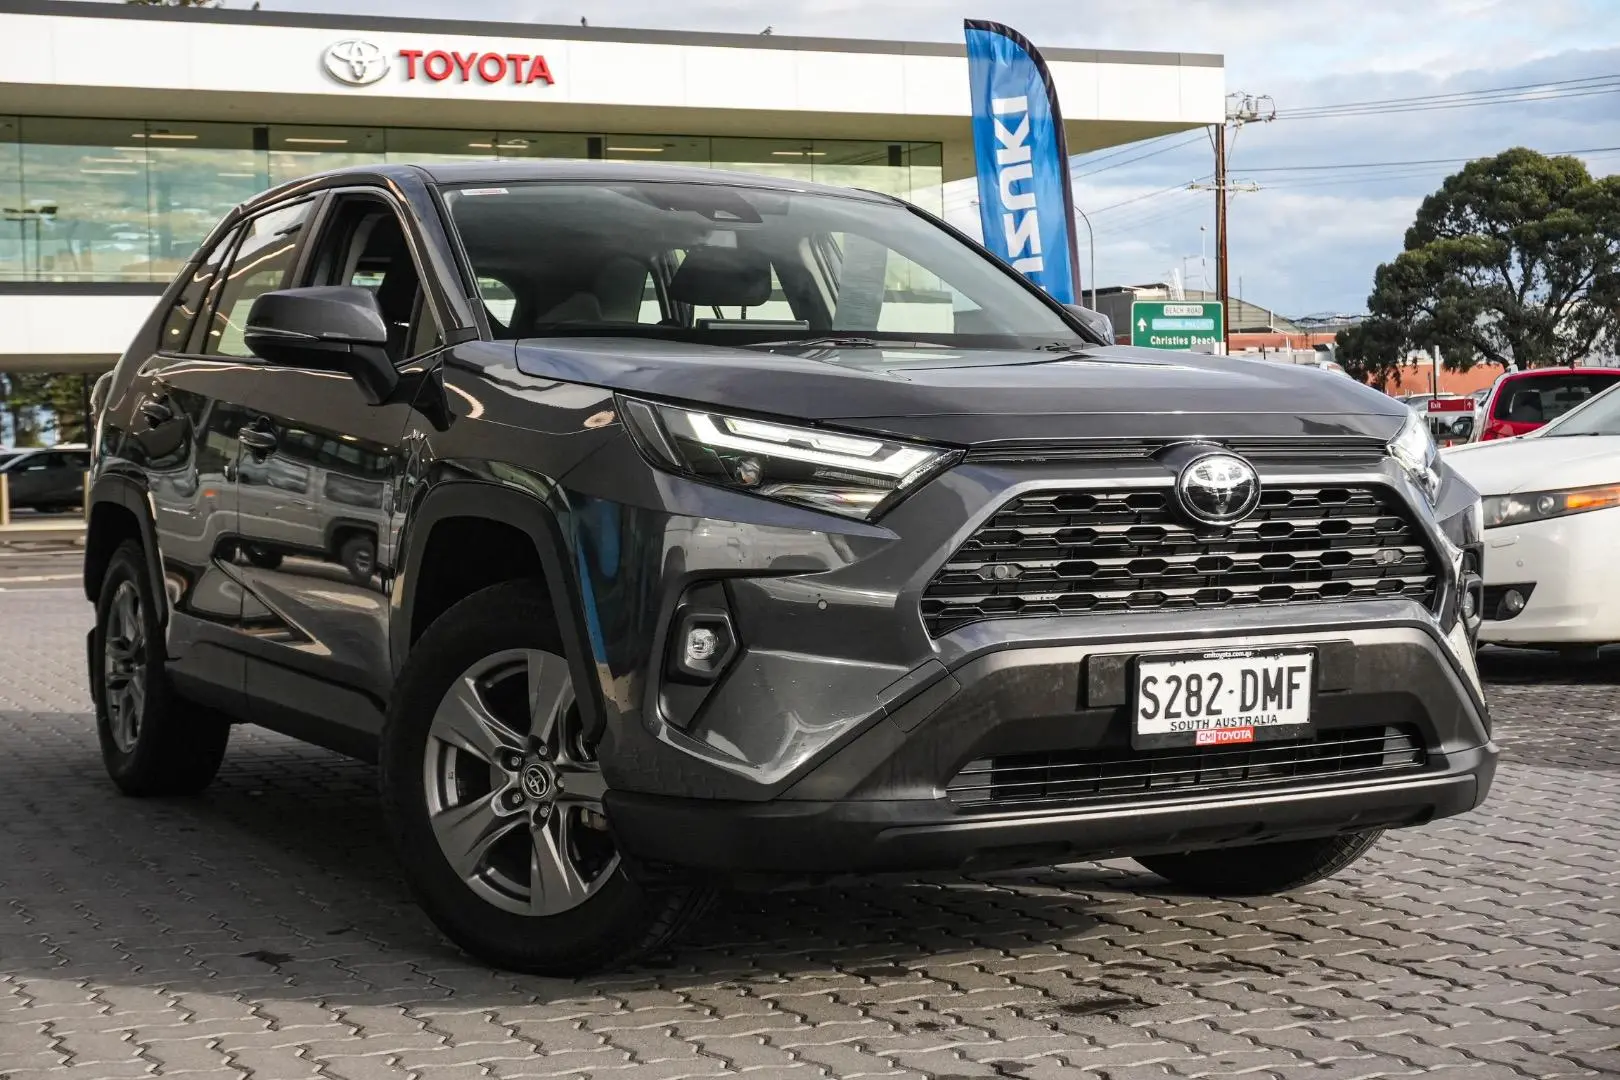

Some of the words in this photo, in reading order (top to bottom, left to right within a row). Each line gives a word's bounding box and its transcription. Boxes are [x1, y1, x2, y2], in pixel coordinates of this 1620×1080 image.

[399, 49, 555, 85] TOYOTA
[1165, 306, 1184, 314] BEACH
[1187, 306, 1203, 314] ROAD
[1150, 335, 1189, 345] Christies
[1191, 335, 1216, 345] Beach
[1430, 401, 1442, 409] Exit
[1170, 718, 1210, 731] SOUTH
[1215, 714, 1278, 728] AUSTRALIA
[1217, 729, 1252, 741] TOYOTA
